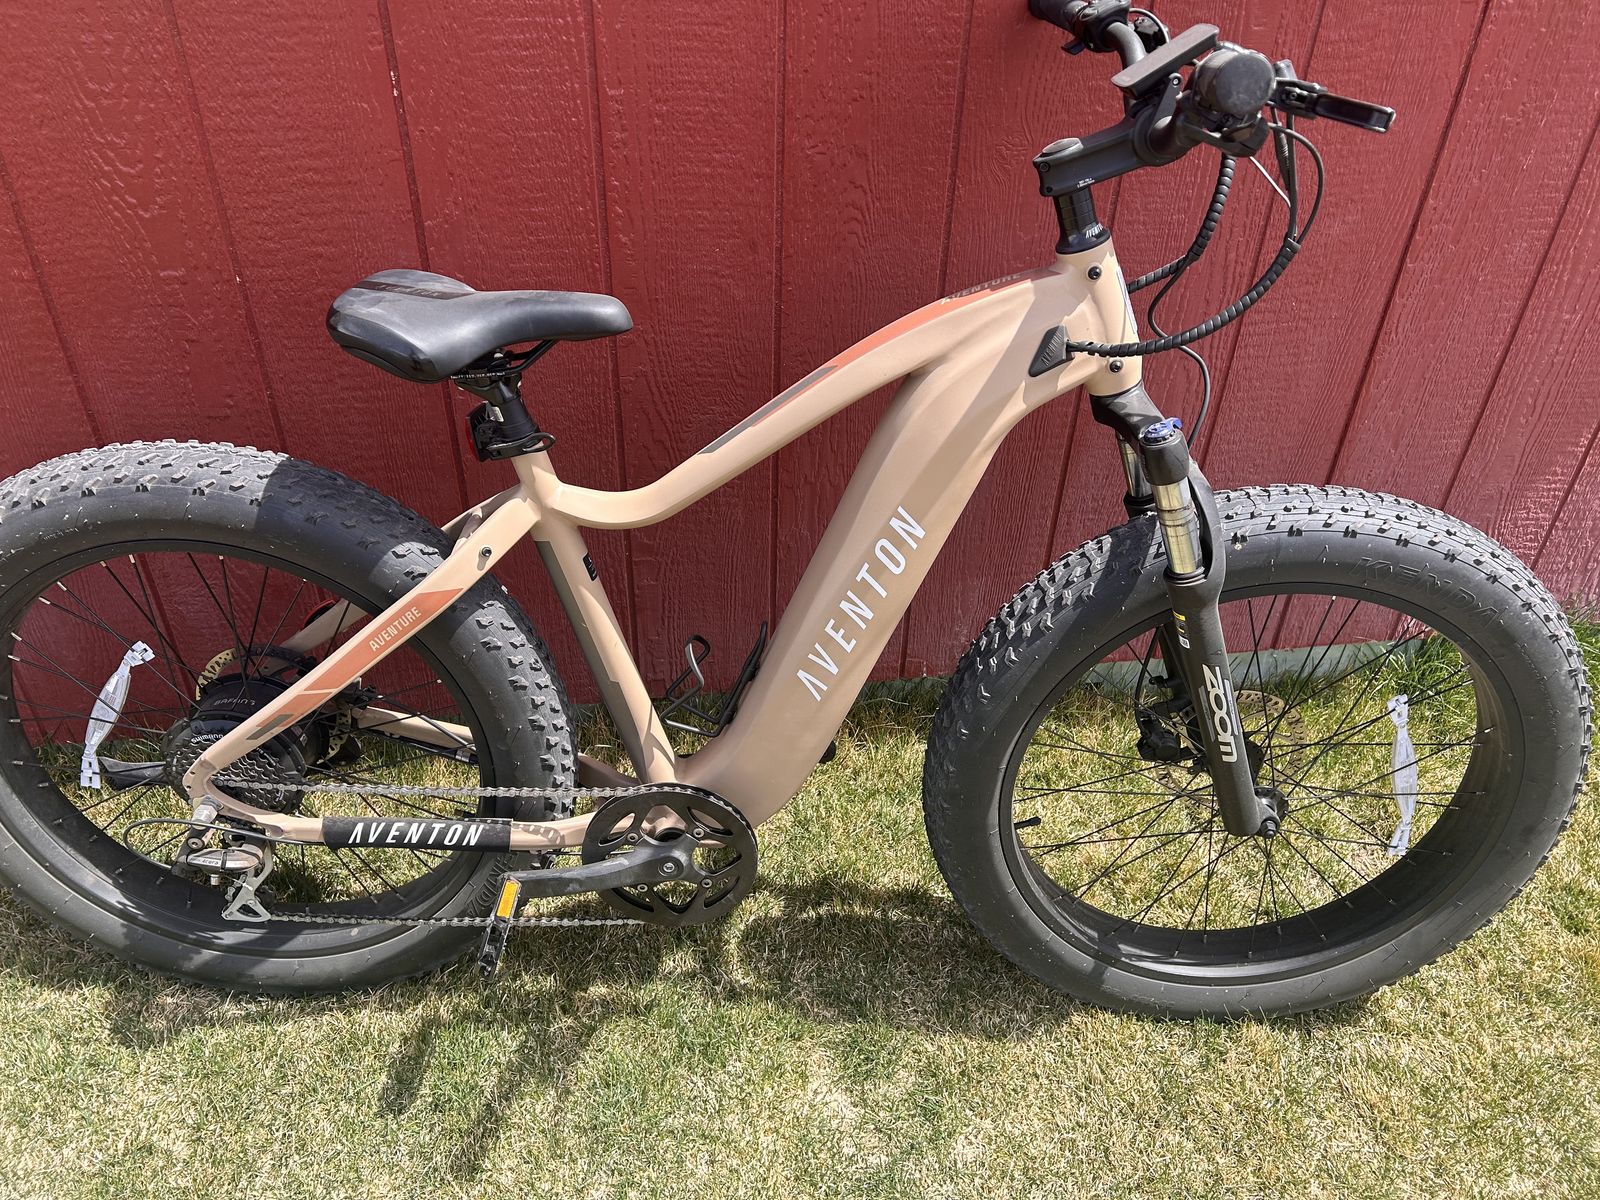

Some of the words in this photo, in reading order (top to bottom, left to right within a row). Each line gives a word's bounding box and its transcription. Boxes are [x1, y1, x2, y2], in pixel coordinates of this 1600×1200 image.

[797, 505, 926, 701] AVENTON
[369, 606, 422, 652] AVENTURE
[348, 822, 484, 847] AVENTON
